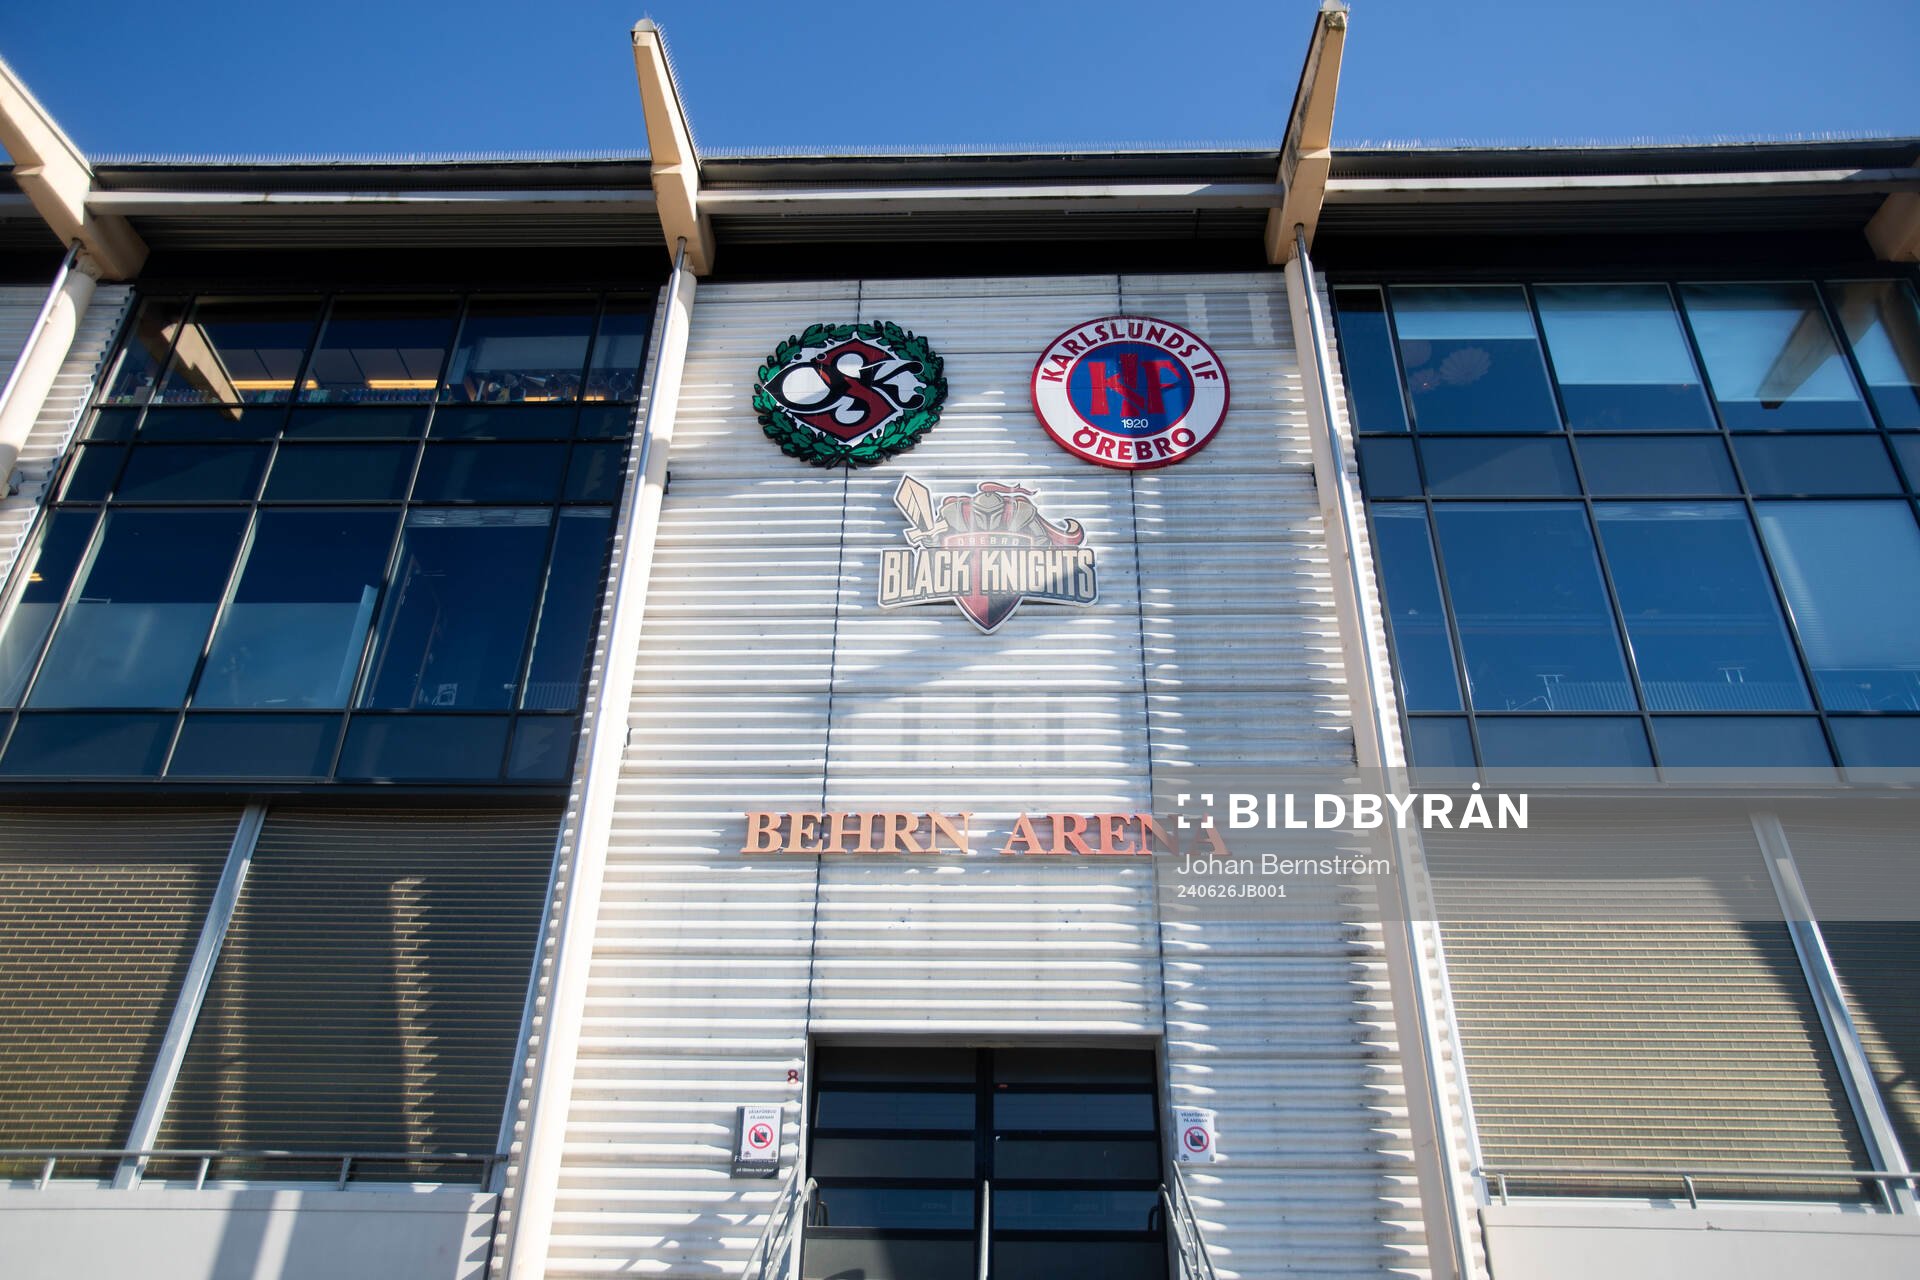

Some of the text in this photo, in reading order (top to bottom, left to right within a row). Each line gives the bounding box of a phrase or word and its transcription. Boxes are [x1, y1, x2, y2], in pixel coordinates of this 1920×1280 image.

[1041, 322, 1218, 382] KARLSLUNDS IF
[1073, 426, 1196, 460] ÖREBRO
[1121, 418, 1149, 429] 1920
[882, 549, 1096, 601] BLACK KNIGHTS
[740, 811, 1233, 857] BEHRN ARENA
[787, 1069, 799, 1084] 8
